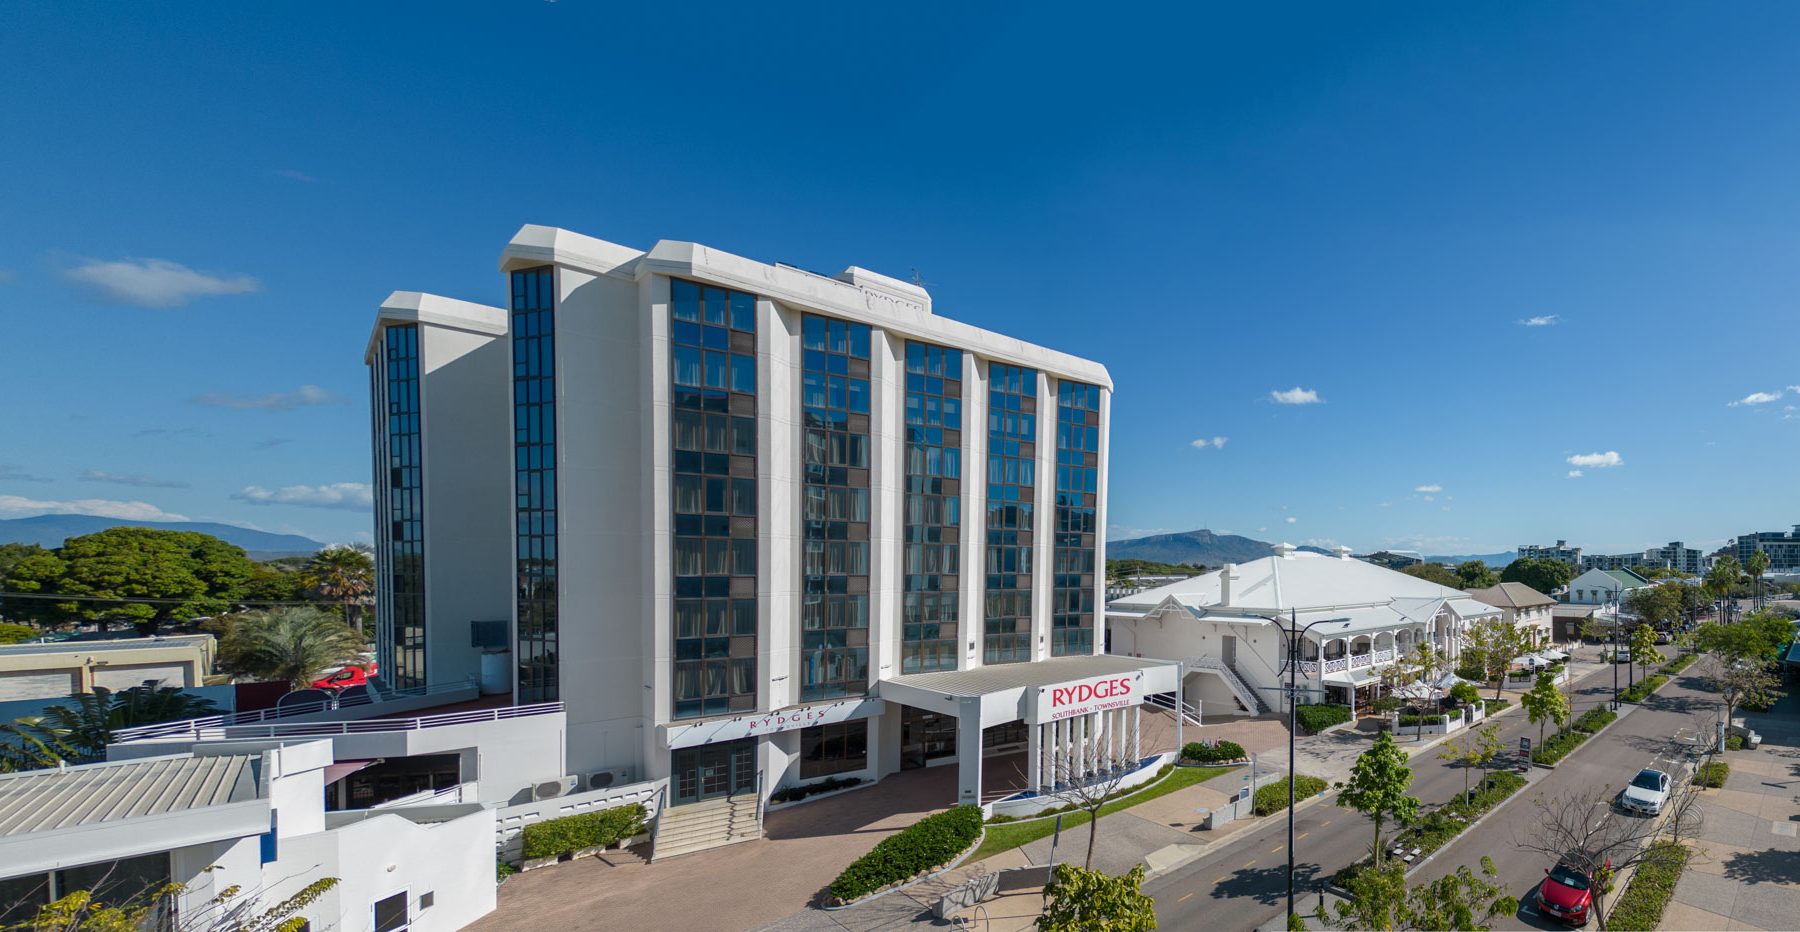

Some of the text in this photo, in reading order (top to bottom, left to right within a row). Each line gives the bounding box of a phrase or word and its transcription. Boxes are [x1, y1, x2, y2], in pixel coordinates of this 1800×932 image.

[1052, 678, 1131, 708] RYDGES
[749, 710, 825, 729] RYDGES
[1051, 699, 1130, 720] SOUTHBANK TOWNSVILLE
